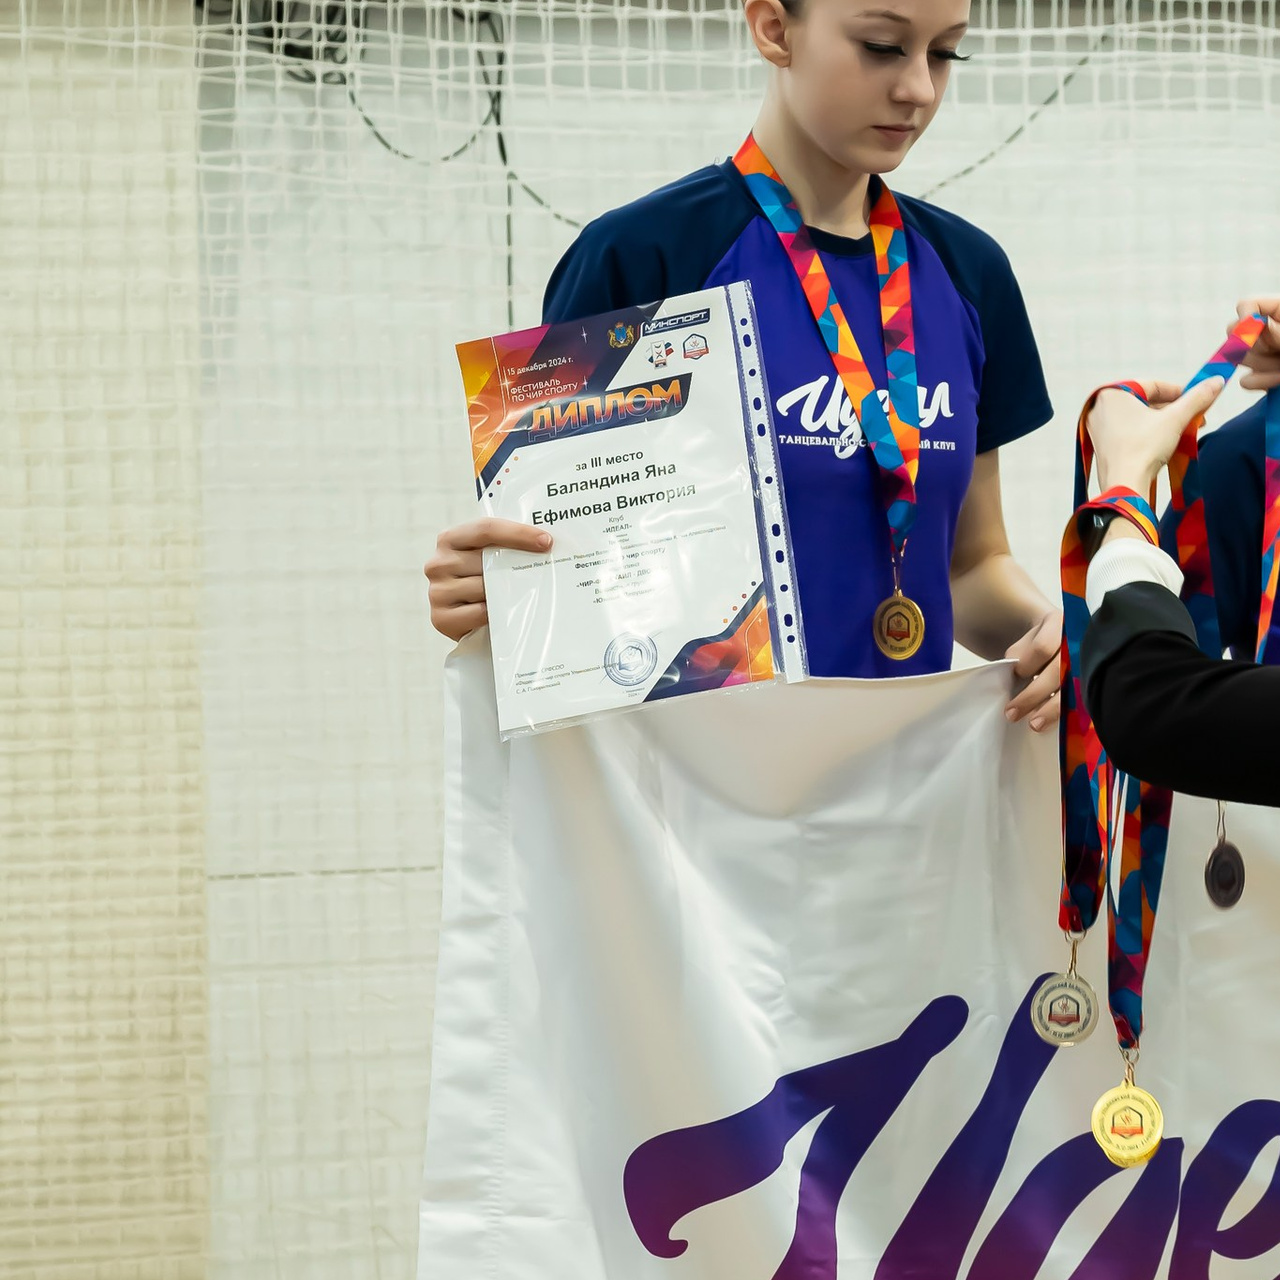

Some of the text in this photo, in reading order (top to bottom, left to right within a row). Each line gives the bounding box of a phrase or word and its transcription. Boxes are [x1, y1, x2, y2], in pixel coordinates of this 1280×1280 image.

[644, 311, 708, 331] МИНСПОРТ
[507, 367, 515, 376] 15
[516, 362, 548, 375] декабря
[548, 357, 568, 369] 2024
[510, 378, 561, 395] ФЕСТИВАЛЬ
[511, 381, 578, 403] ПО ЧИР СПОРТУ
[528, 378, 683, 443] ДИПЛОМ
[575, 450, 644, 472] за III место
[547, 463, 677, 497] Баландина Яна
[532, 484, 697, 526] Ефимова Виктория
[608, 515, 624, 524] Клуб
[575, 557, 617, 570] Фестивал
[626, 550, 640, 560] чир
[641, 547, 666, 557] спорту
